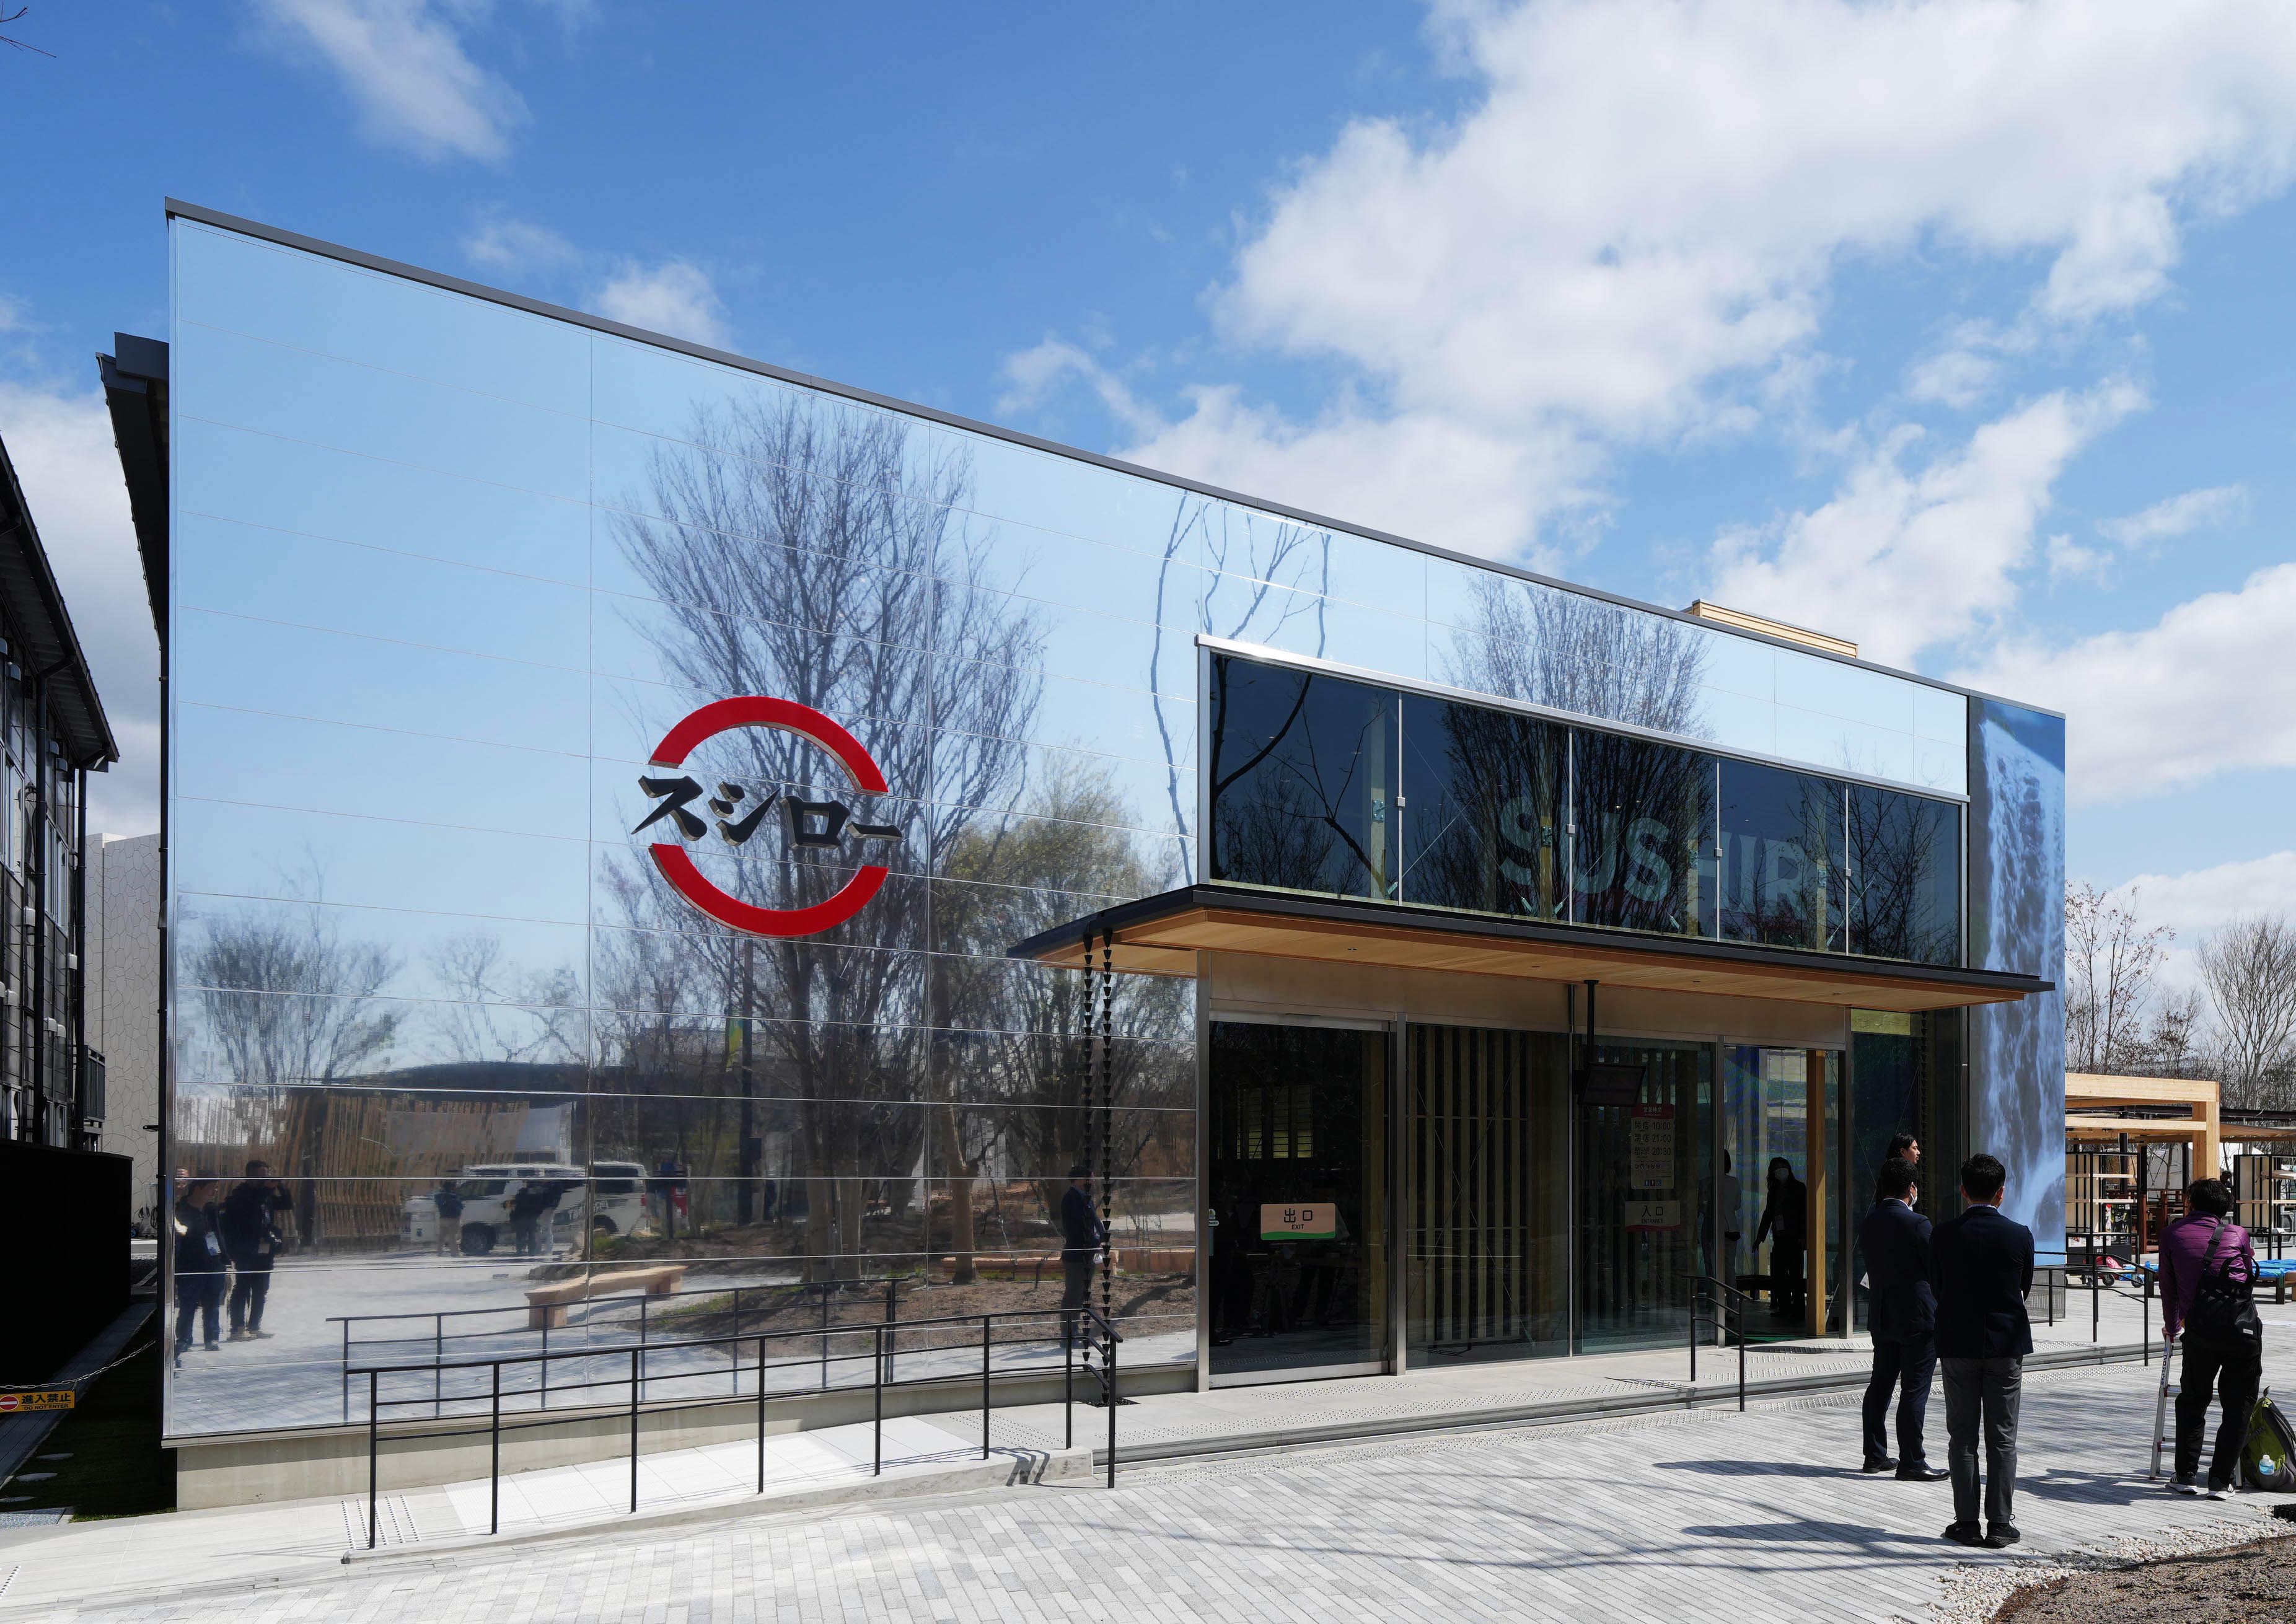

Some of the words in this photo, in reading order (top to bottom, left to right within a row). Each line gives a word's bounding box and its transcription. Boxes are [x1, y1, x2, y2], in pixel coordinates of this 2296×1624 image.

[631, 775, 902, 849] スシロー
[1653, 1121, 1671, 1130] 10:00
[1652, 1134, 1671, 1143] 21:00
[1652, 1147, 1671, 1156] 20:30
[1283, 1208, 1313, 1223] 出口
[1641, 1205, 1663, 1218] 入口
[21, 1392, 71, 1405] 進入禁止
